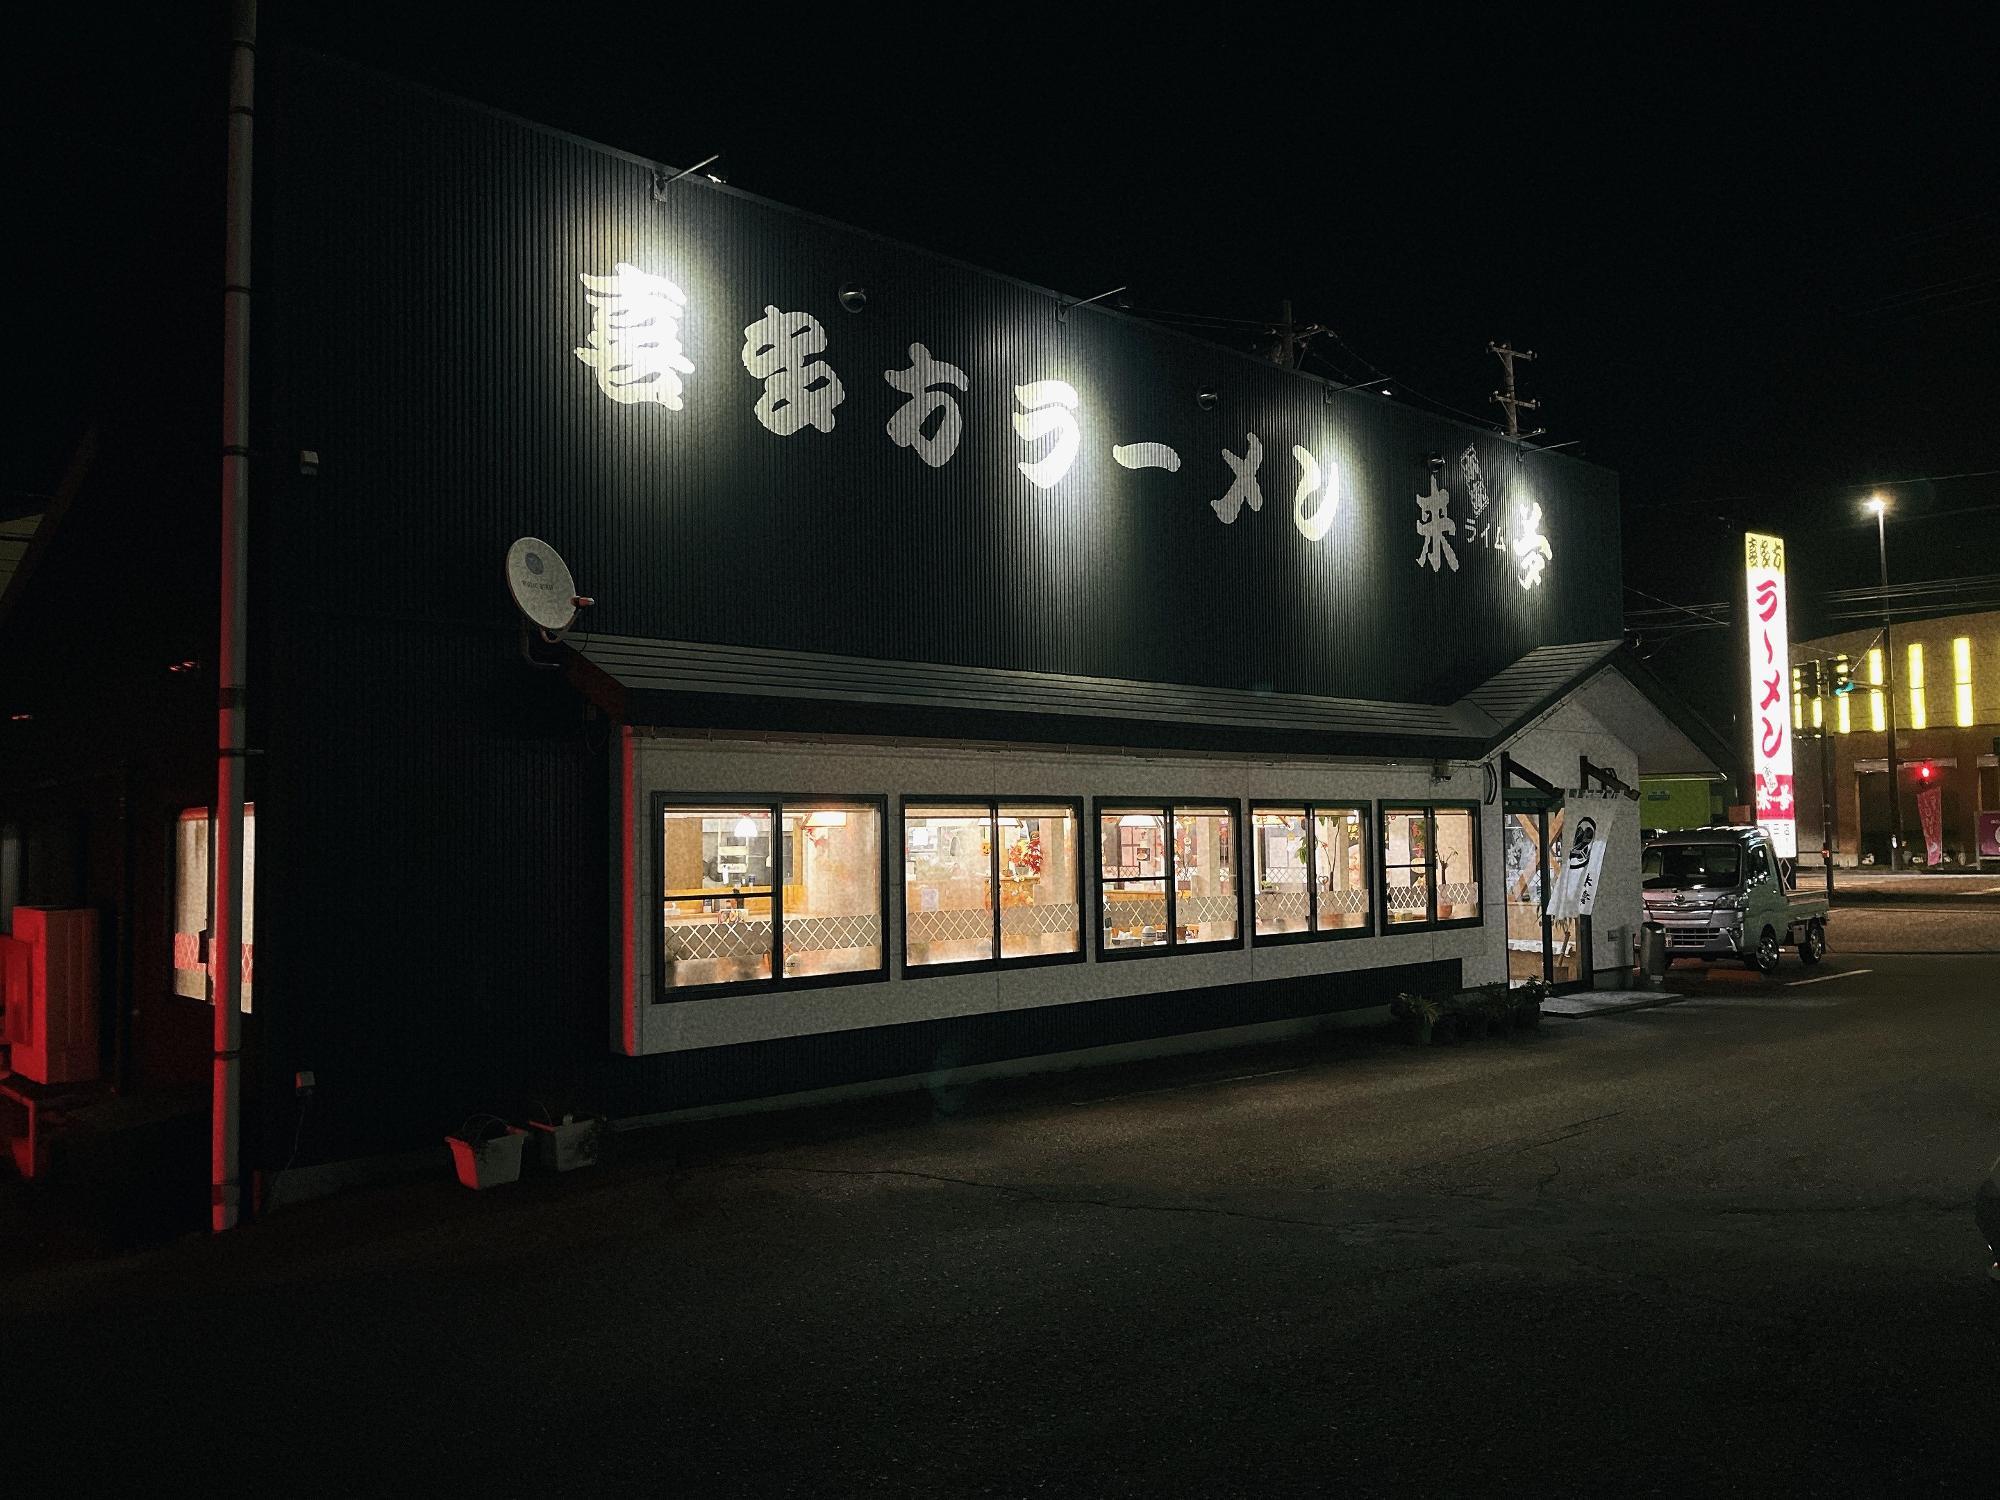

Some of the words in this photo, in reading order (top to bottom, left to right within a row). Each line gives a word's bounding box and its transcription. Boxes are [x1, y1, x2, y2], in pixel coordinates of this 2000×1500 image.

[1464, 518, 1506, 551] ライム
[1756, 580, 1783, 758] ラーメン
